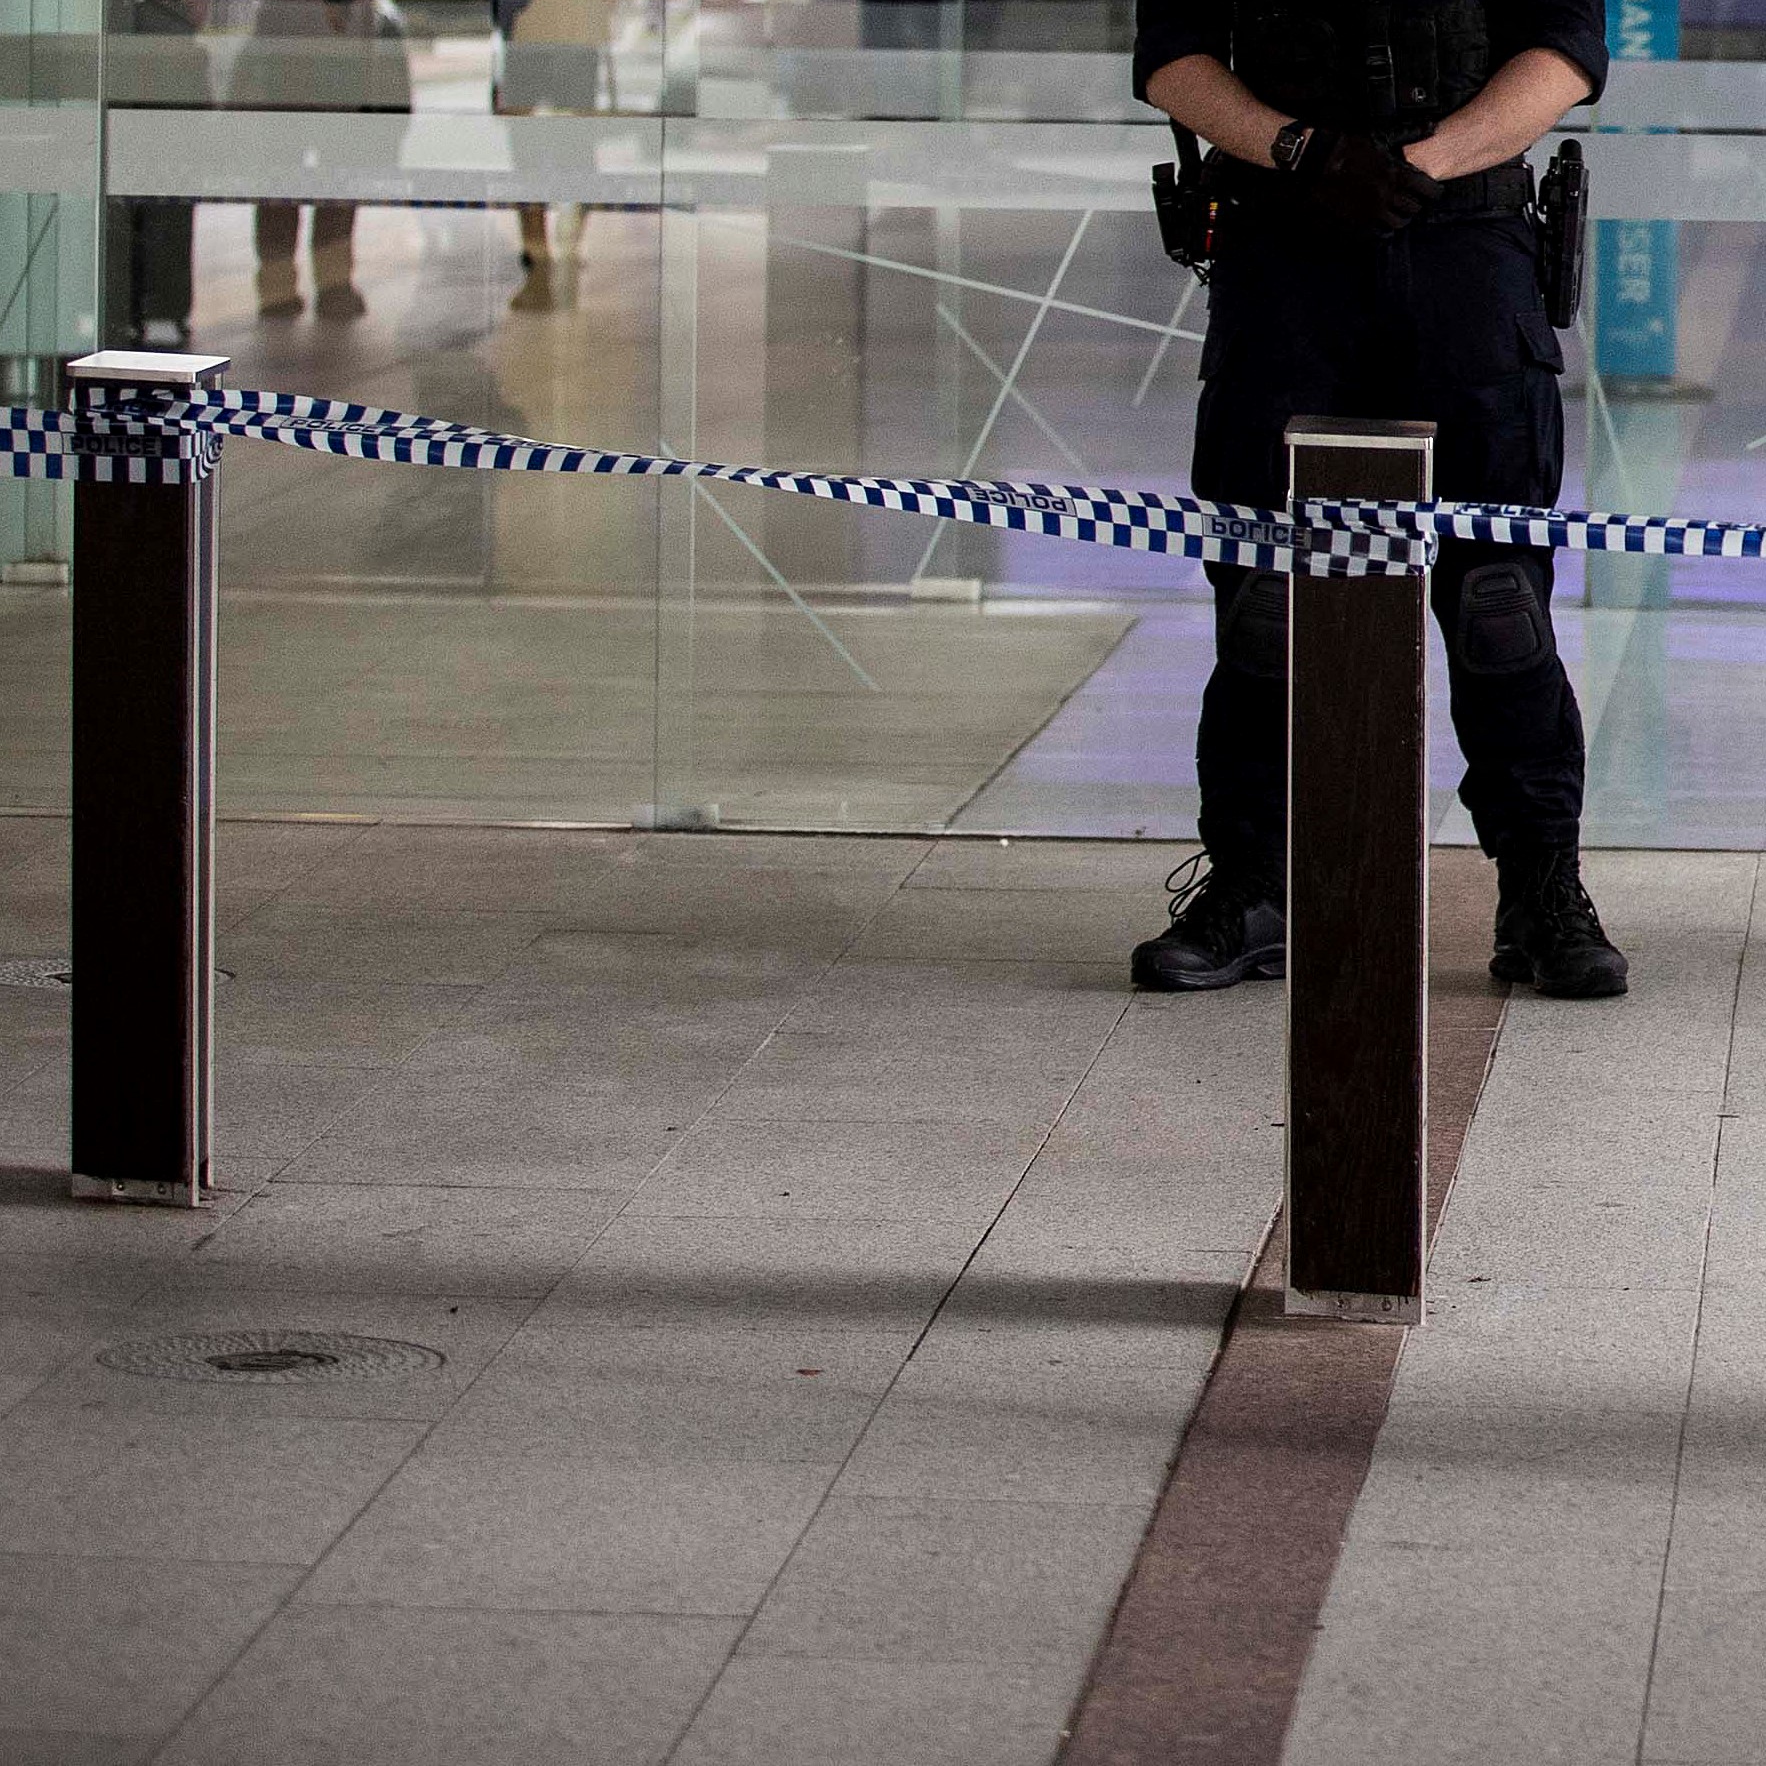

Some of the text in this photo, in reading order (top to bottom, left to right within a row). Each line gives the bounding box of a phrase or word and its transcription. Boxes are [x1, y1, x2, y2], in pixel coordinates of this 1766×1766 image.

[290, 419, 379, 433] POLICE
[72, 434, 159, 455] POLICE
[973, 489, 1068, 513] POLICE
